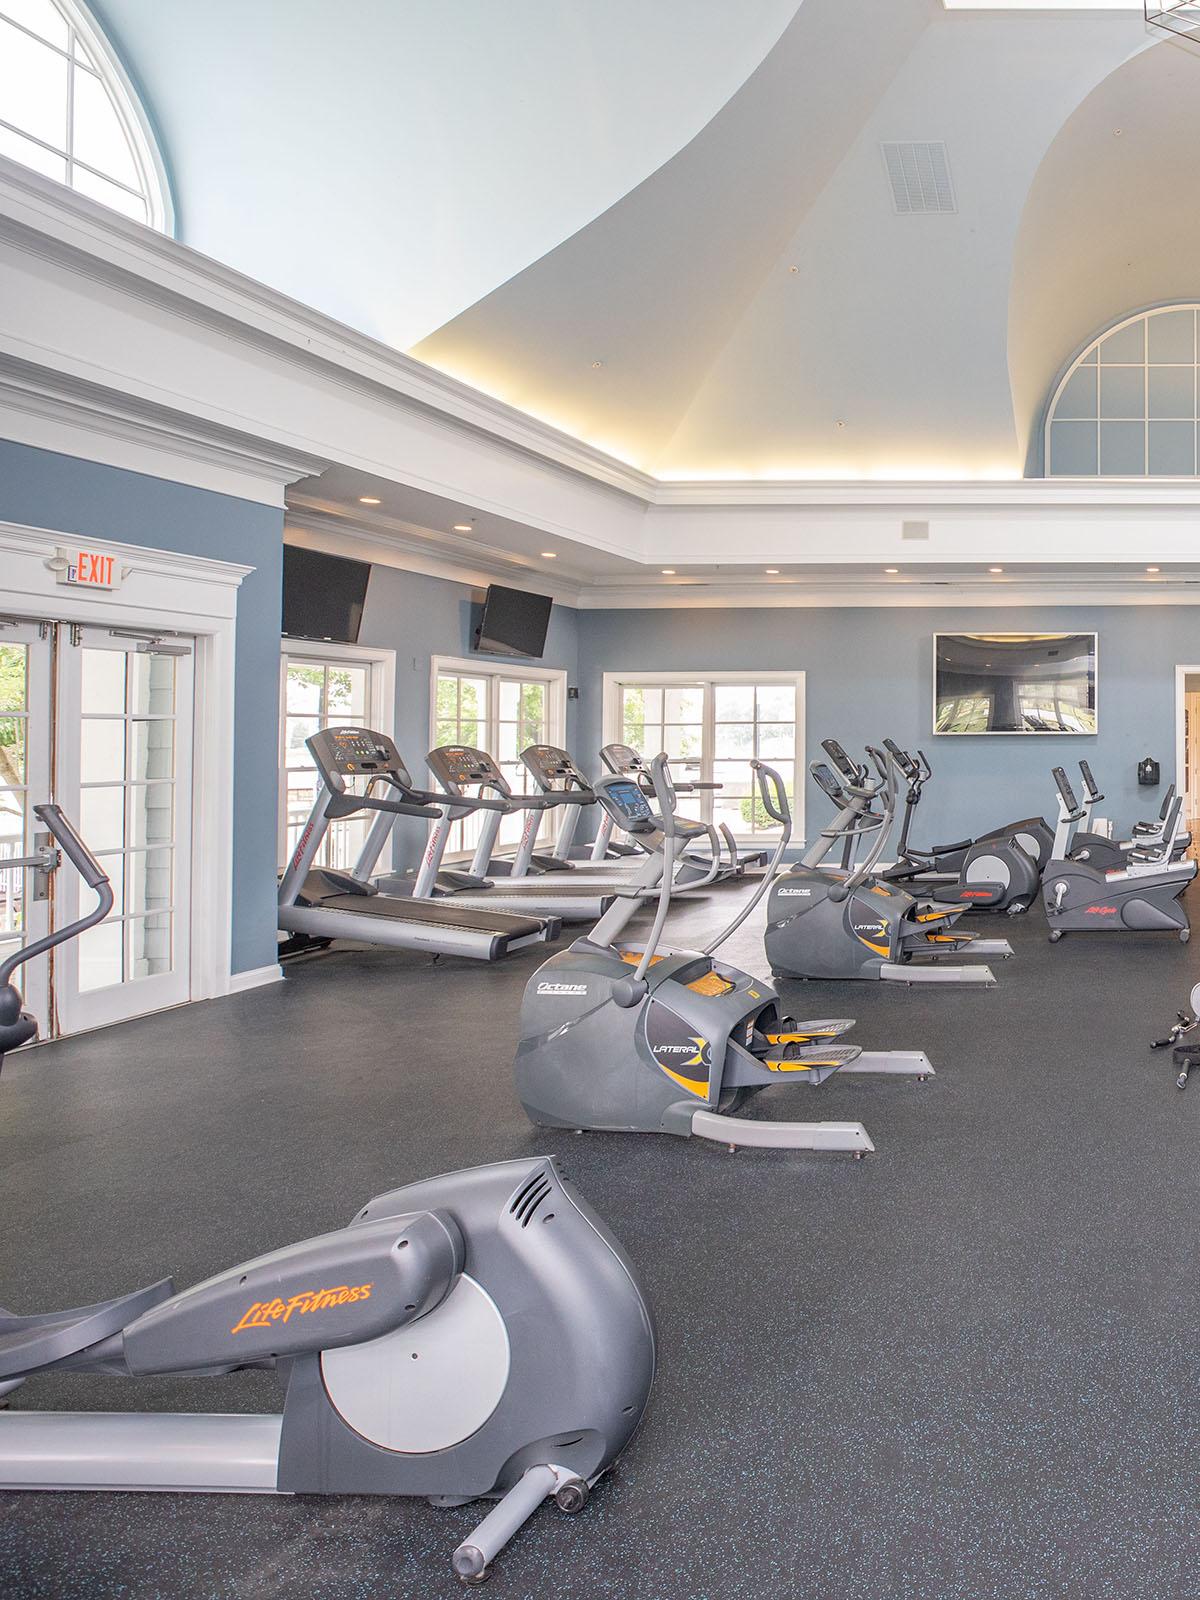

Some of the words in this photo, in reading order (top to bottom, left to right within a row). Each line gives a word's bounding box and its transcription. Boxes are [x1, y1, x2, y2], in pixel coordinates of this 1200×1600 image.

[78, 552, 115, 585] EXIT
[537, 982, 588, 991] Octane
[653, 1045, 699, 1053] LATERAL
